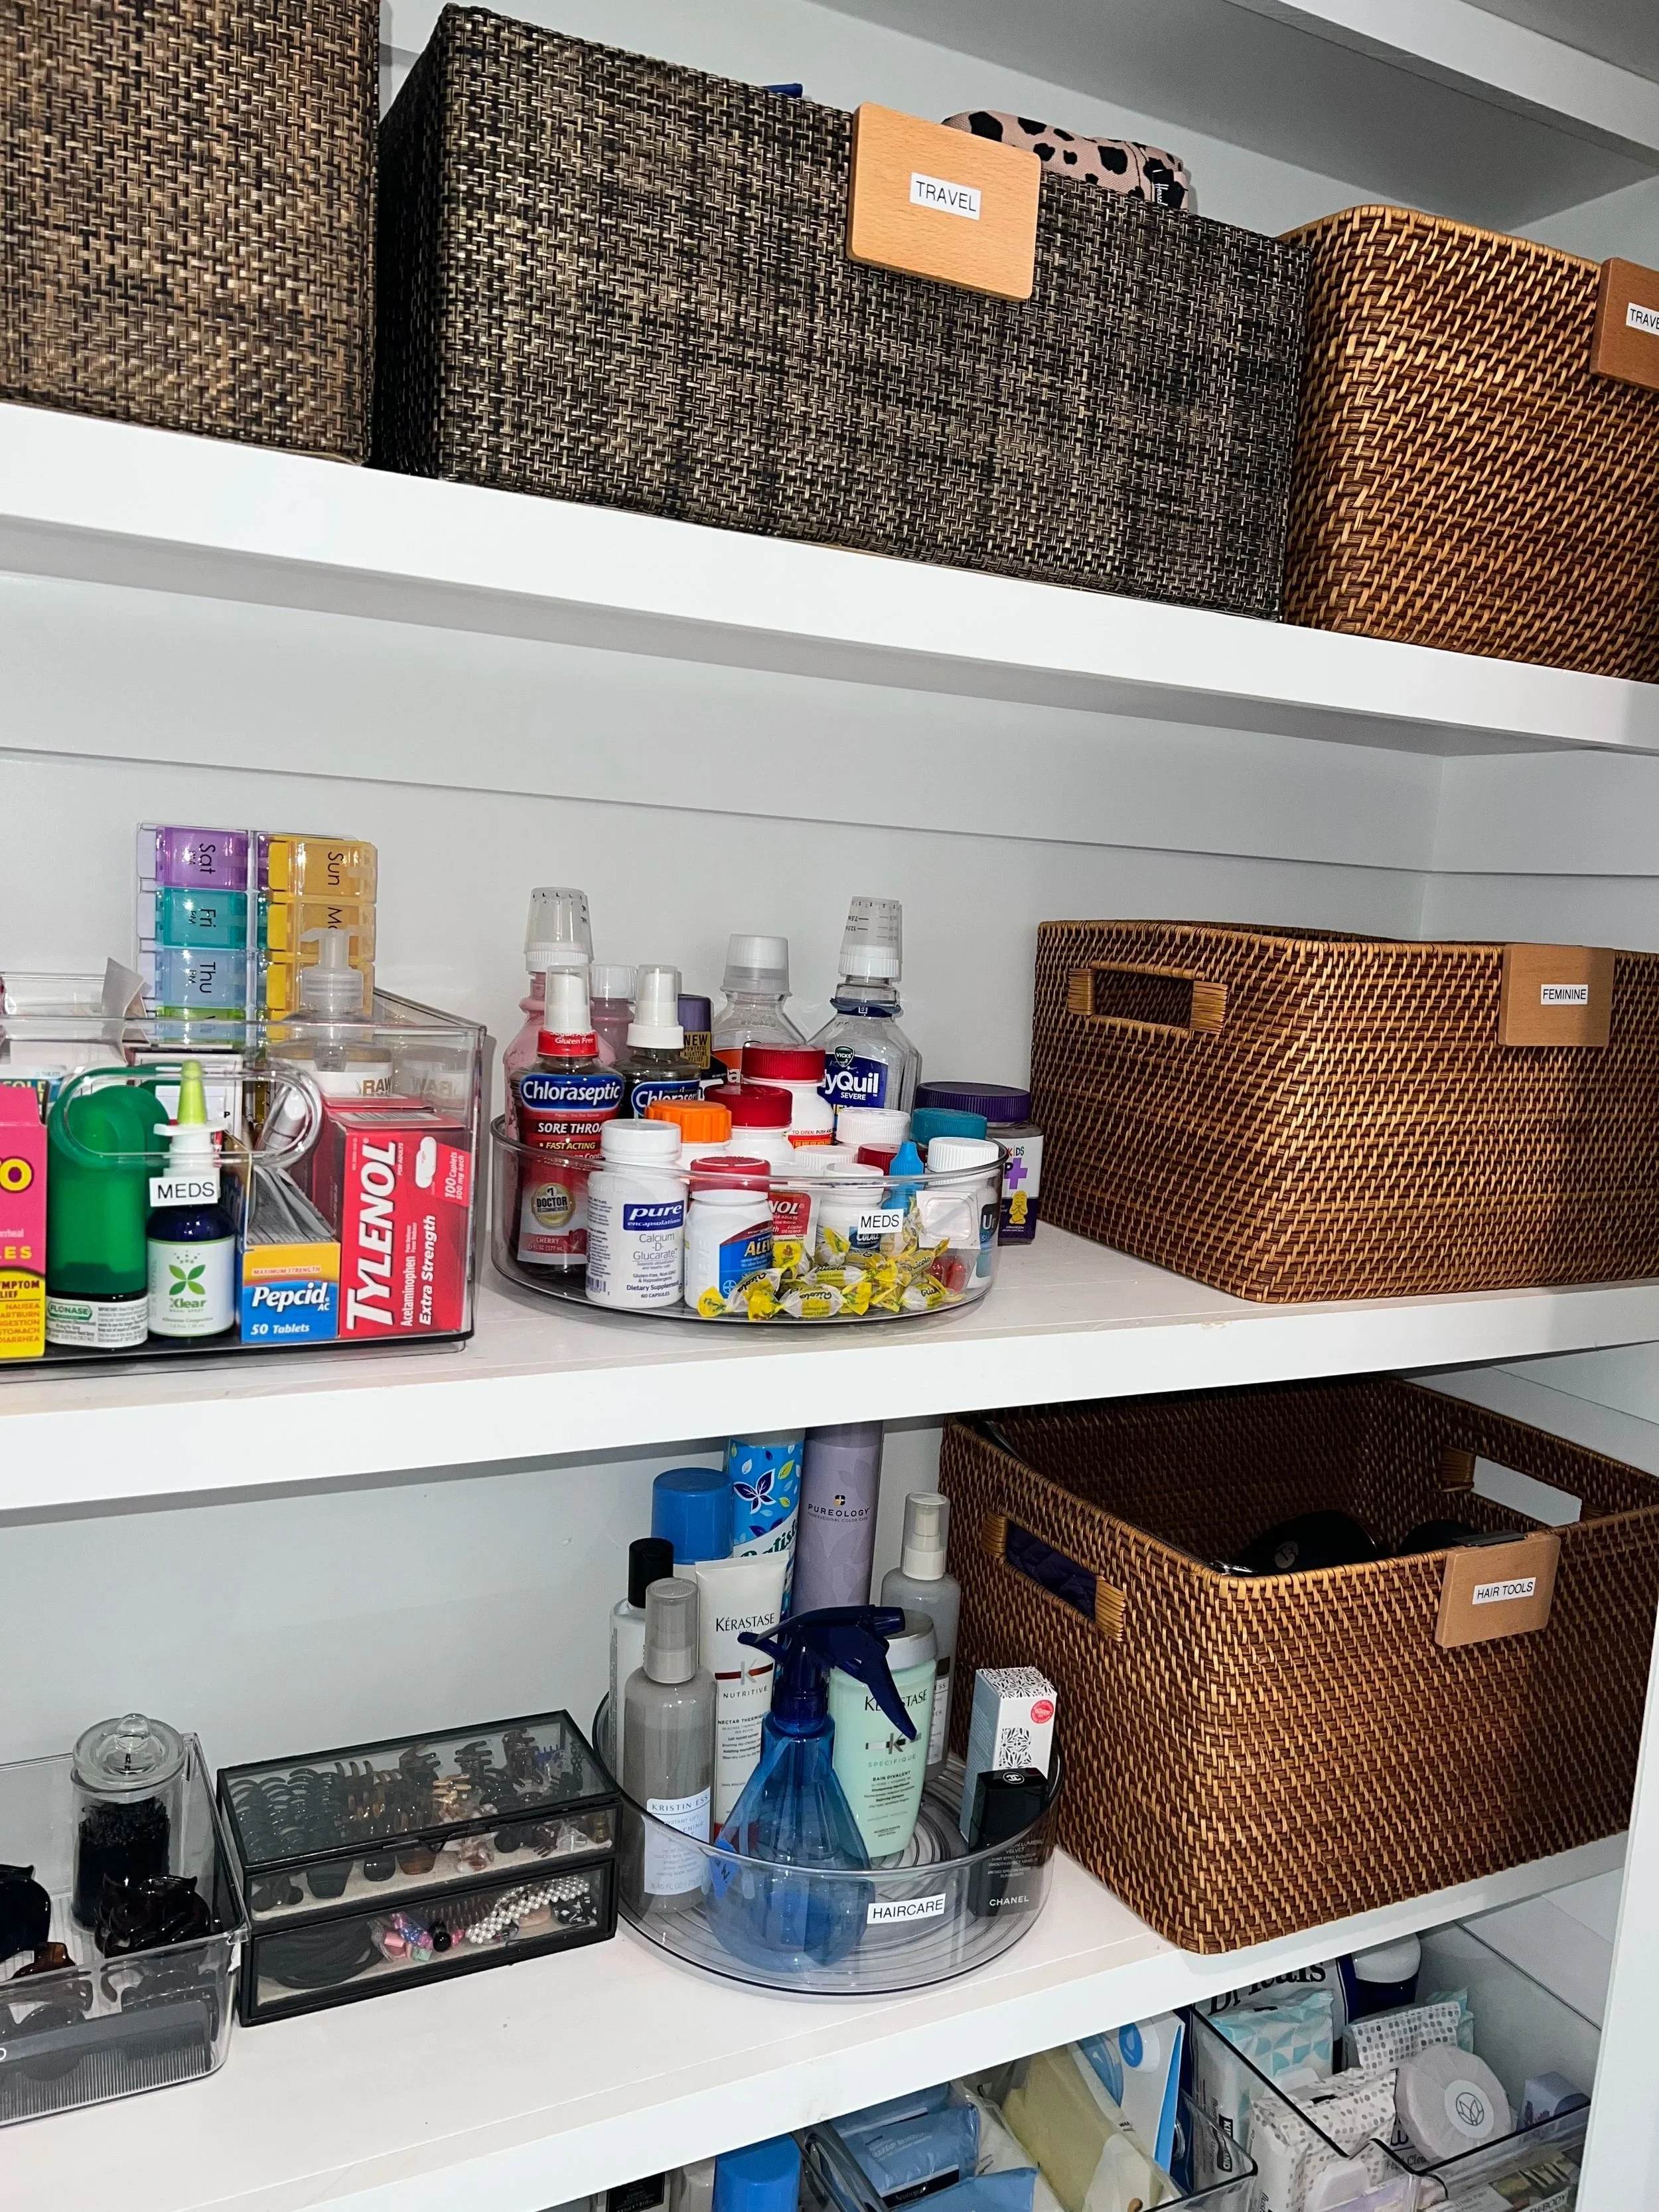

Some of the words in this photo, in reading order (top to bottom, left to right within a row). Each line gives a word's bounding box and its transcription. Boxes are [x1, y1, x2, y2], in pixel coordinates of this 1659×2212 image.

[916, 181, 976, 212] TRAVEL
[1630, 309, 1659, 330] TRAVE
[199, 843, 216, 875] Sat
[328, 851, 344, 886] Sun
[199, 908, 216, 928] Fri
[199, 962, 216, 994] Thu
[1543, 988, 1587, 1000] FEMININE
[684, 1034, 708, 1046] NEW
[362, 1077, 393, 1096] RAW
[825, 1069, 879, 1095] yQuil
[522, 1080, 621, 1106] Chloraseptic
[841, 1092, 867, 1101] SEVERE
[538, 1122, 568, 1134] SORE
[570, 1123, 603, 1134] THRO
[449, 1151, 459, 1177] Caplets
[456, 1171, 465, 1186] mg
[157, 1181, 216, 1200] MEDS
[443, 1177, 458, 1199] 100
[536, 1196, 568, 1208] DOCTOR
[629, 1205, 683, 1220] pure
[627, 1218, 682, 1228] encapsulations
[860, 1214, 900, 1228] MEDS
[346, 1140, 397, 1331] TYLENOL
[639, 1232, 675, 1244] Calcium
[421, 1215, 438, 1282] Strength
[0, 1280, 40, 1289] MPTOM
[400, 1255, 417, 1327] Acetaminophen
[650, 1281, 679, 1291] Supplement
[0, 1290, 18, 1299] LIEF
[252, 1282, 328, 1313] Pepcid
[50, 1304, 88, 1315] FLONASE
[317, 1303, 330, 1312] AC
[419, 1284, 433, 1326] Extra
[250, 1323, 269, 1335] 50
[273, 1323, 310, 1334] Tablets
[808, 1503, 869, 1517] PUREOLOGY
[808, 1511, 839, 1522] PROFESSIONAL
[1477, 1587, 1500, 1599] HAIR
[1502, 1581, 1534, 1595] TOOLS
[715, 1612, 775, 1632] KÉRASTASE
[723, 1685, 768, 1698] NUTRITIVE
[887, 1770, 911, 1779] DIVALENT
[652, 1802, 691, 1812] KRISTIN
[695, 1794, 709, 1806] ESS
[872, 1898, 944, 1920] HAIRCARE
[989, 1895, 1029, 1907] CHANEL
